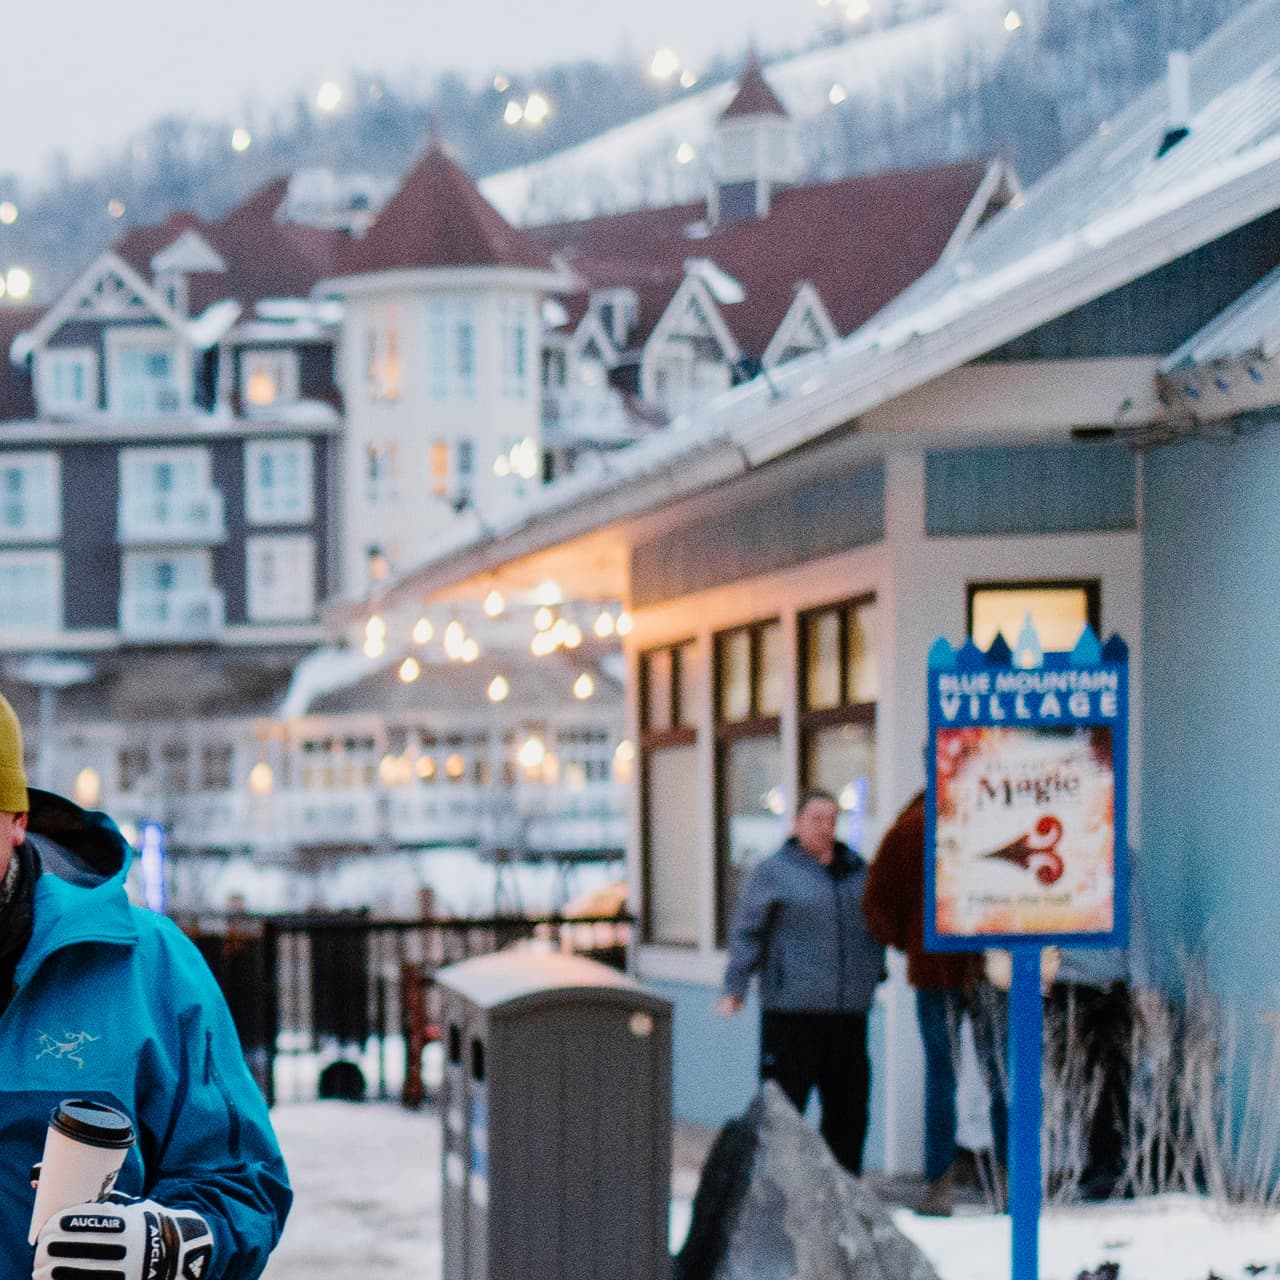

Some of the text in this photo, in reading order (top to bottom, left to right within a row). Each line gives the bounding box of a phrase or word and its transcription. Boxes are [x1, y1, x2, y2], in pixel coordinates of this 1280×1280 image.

[939, 671, 1119, 694] BLUE MOUNTAIN
[939, 692, 1119, 720] VILLAGE
[978, 770, 1079, 808] Magic
[70, 1217, 121, 1229] AUCLAIR
